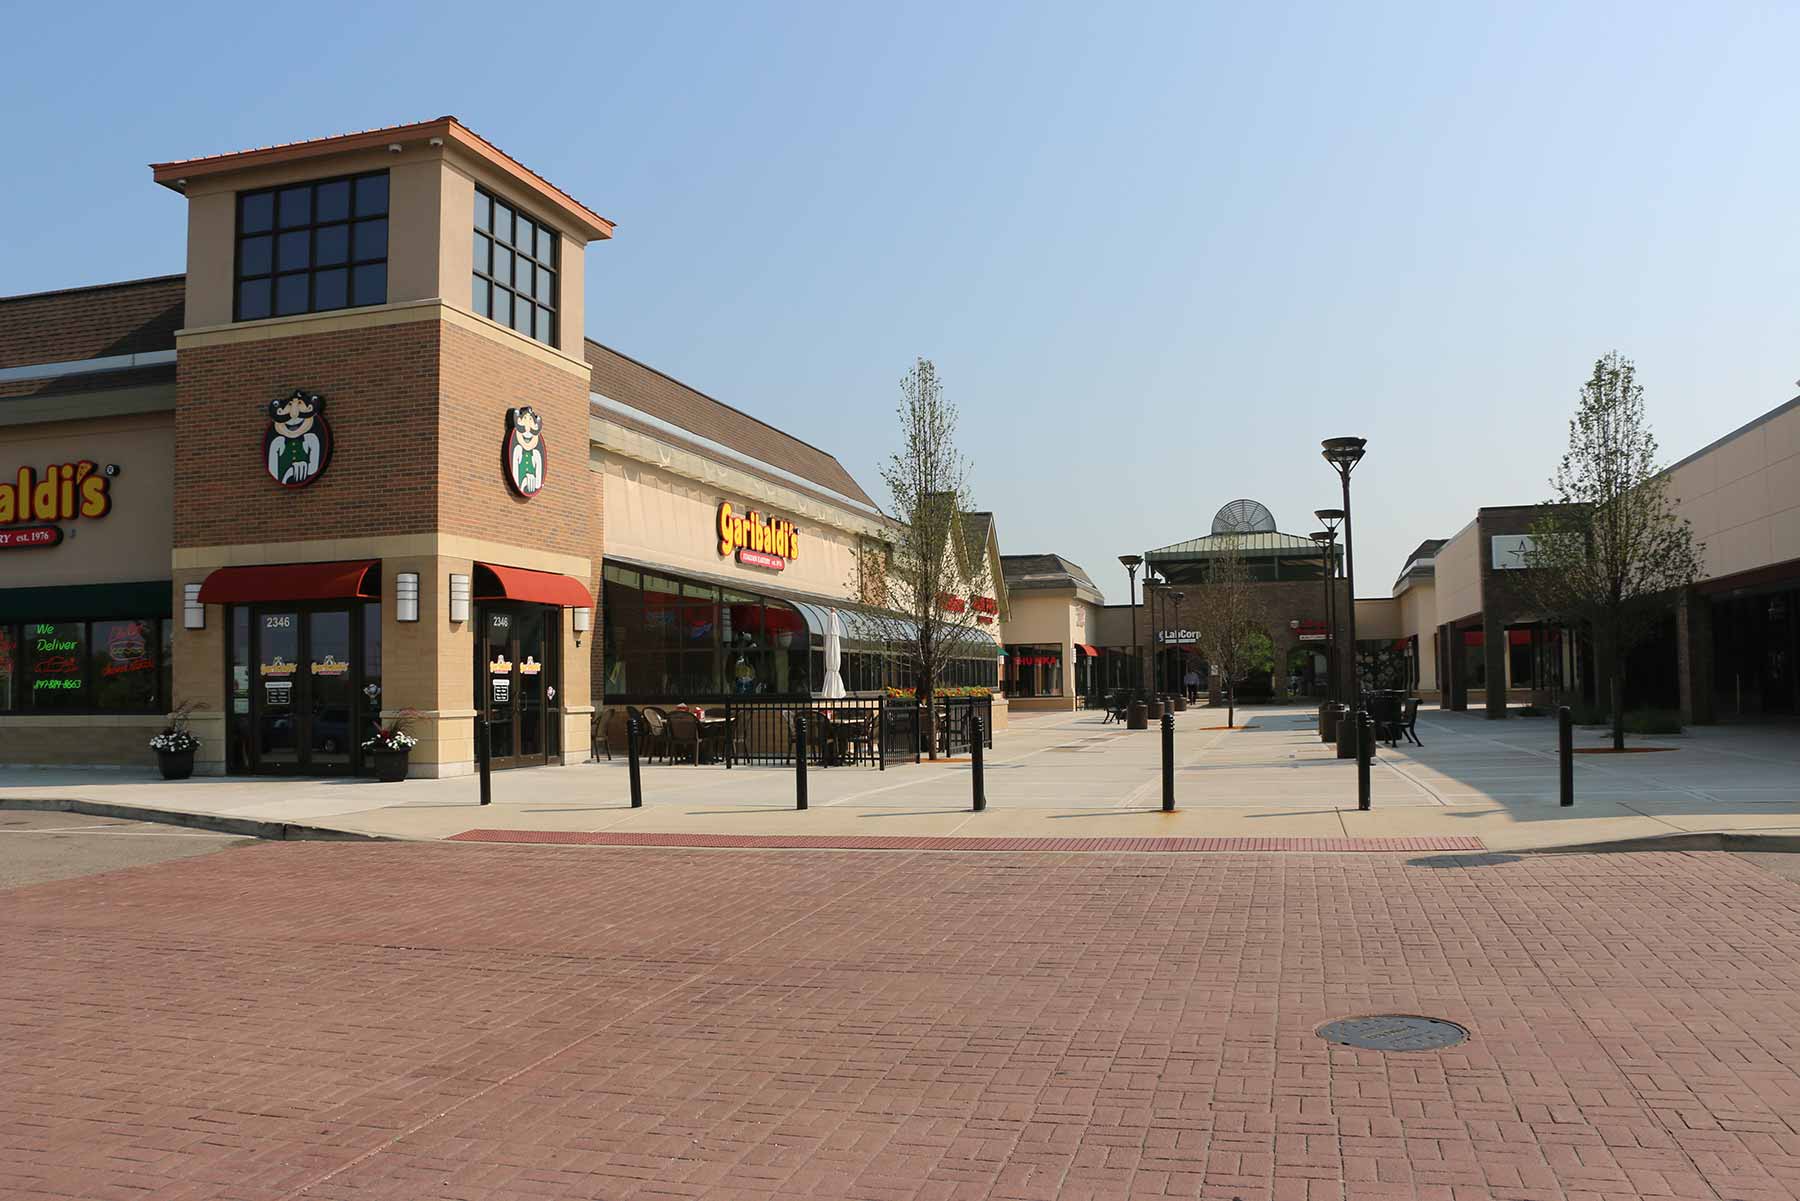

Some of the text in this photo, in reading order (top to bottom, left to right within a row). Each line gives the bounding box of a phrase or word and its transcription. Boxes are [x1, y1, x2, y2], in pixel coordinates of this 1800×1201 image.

[16, 534, 29, 542] est.
[31, 531, 49, 541] 1976
[719, 502, 799, 560] Garibaldi's
[266, 616, 290, 628] 2346
[493, 616, 509, 628] 2346
[36, 623, 55, 635] We
[1165, 630, 1202, 640] LabCorp
[37, 639, 78, 651] Deliver
